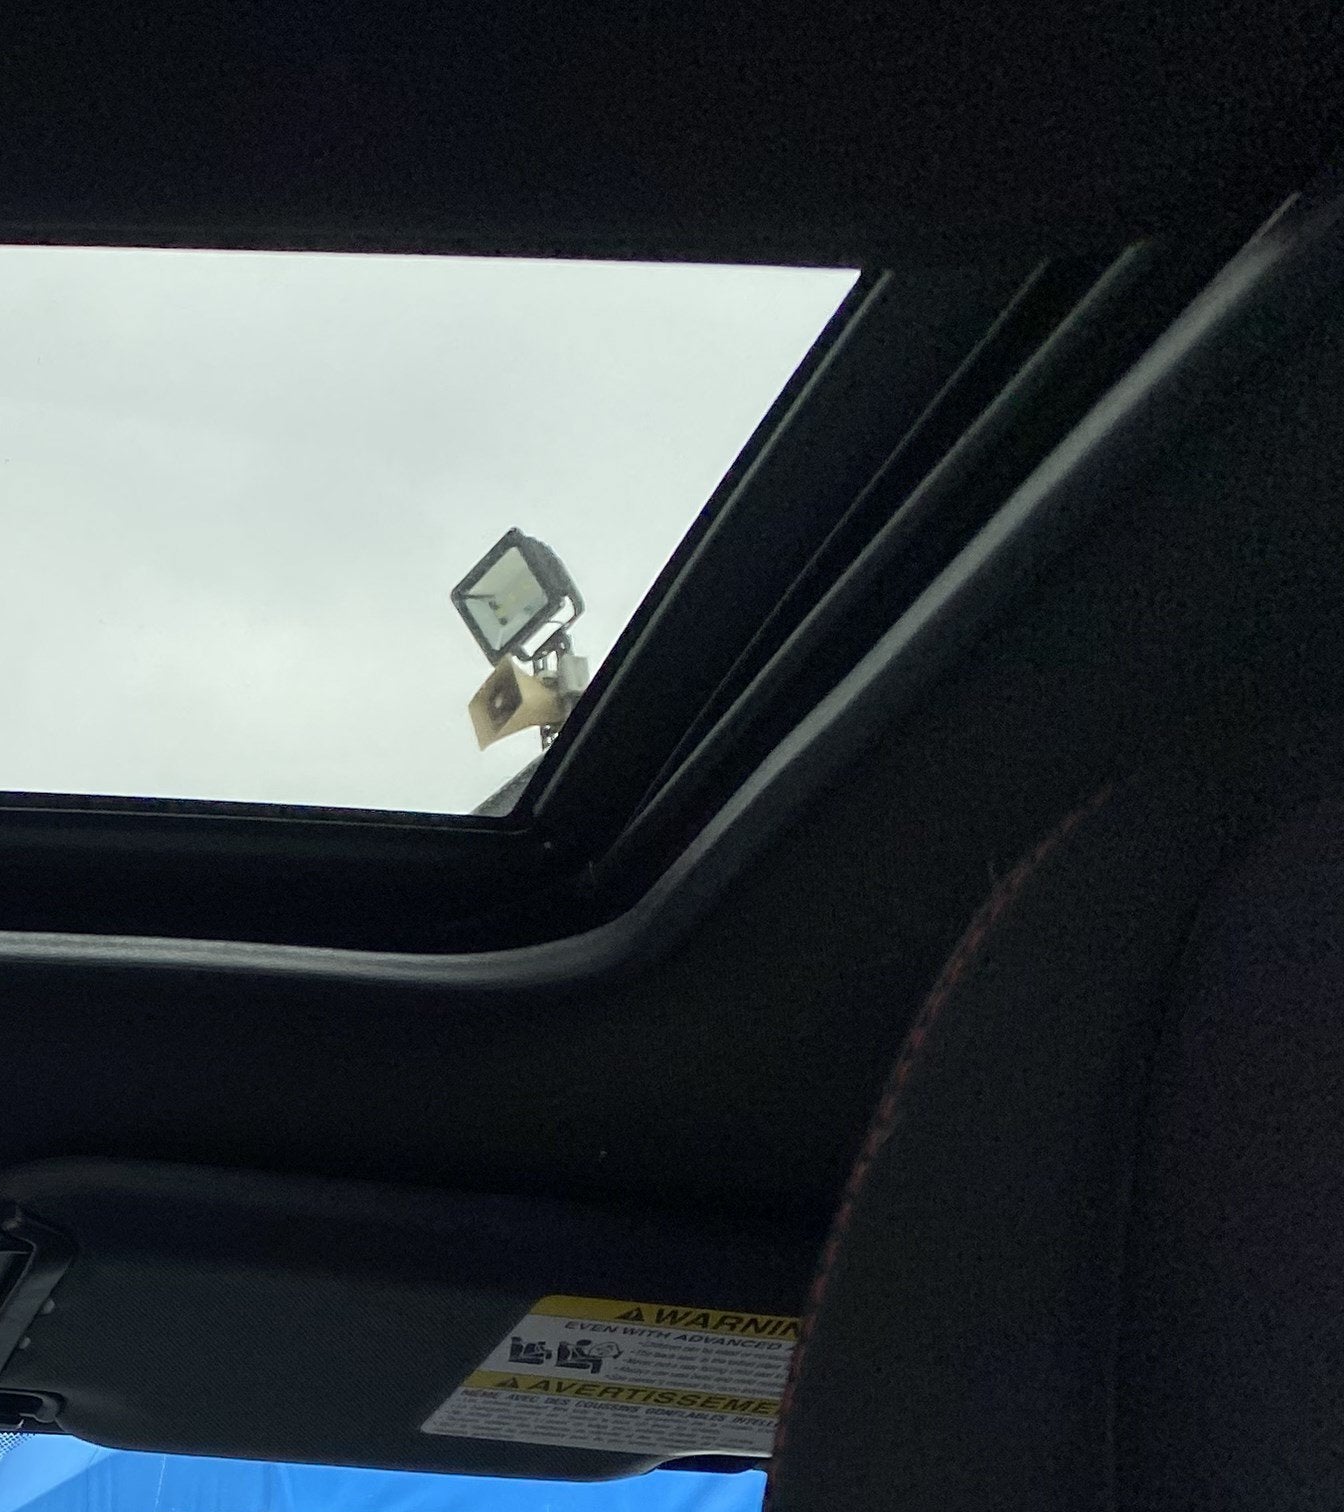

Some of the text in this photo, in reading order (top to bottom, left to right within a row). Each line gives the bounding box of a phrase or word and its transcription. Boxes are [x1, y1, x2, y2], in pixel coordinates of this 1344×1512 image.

[564, 1321, 784, 1351] EVEN WITH ADVANCED
[654, 1308, 800, 1338] WARNIN
[527, 1378, 780, 1415] AVERTISSEME
